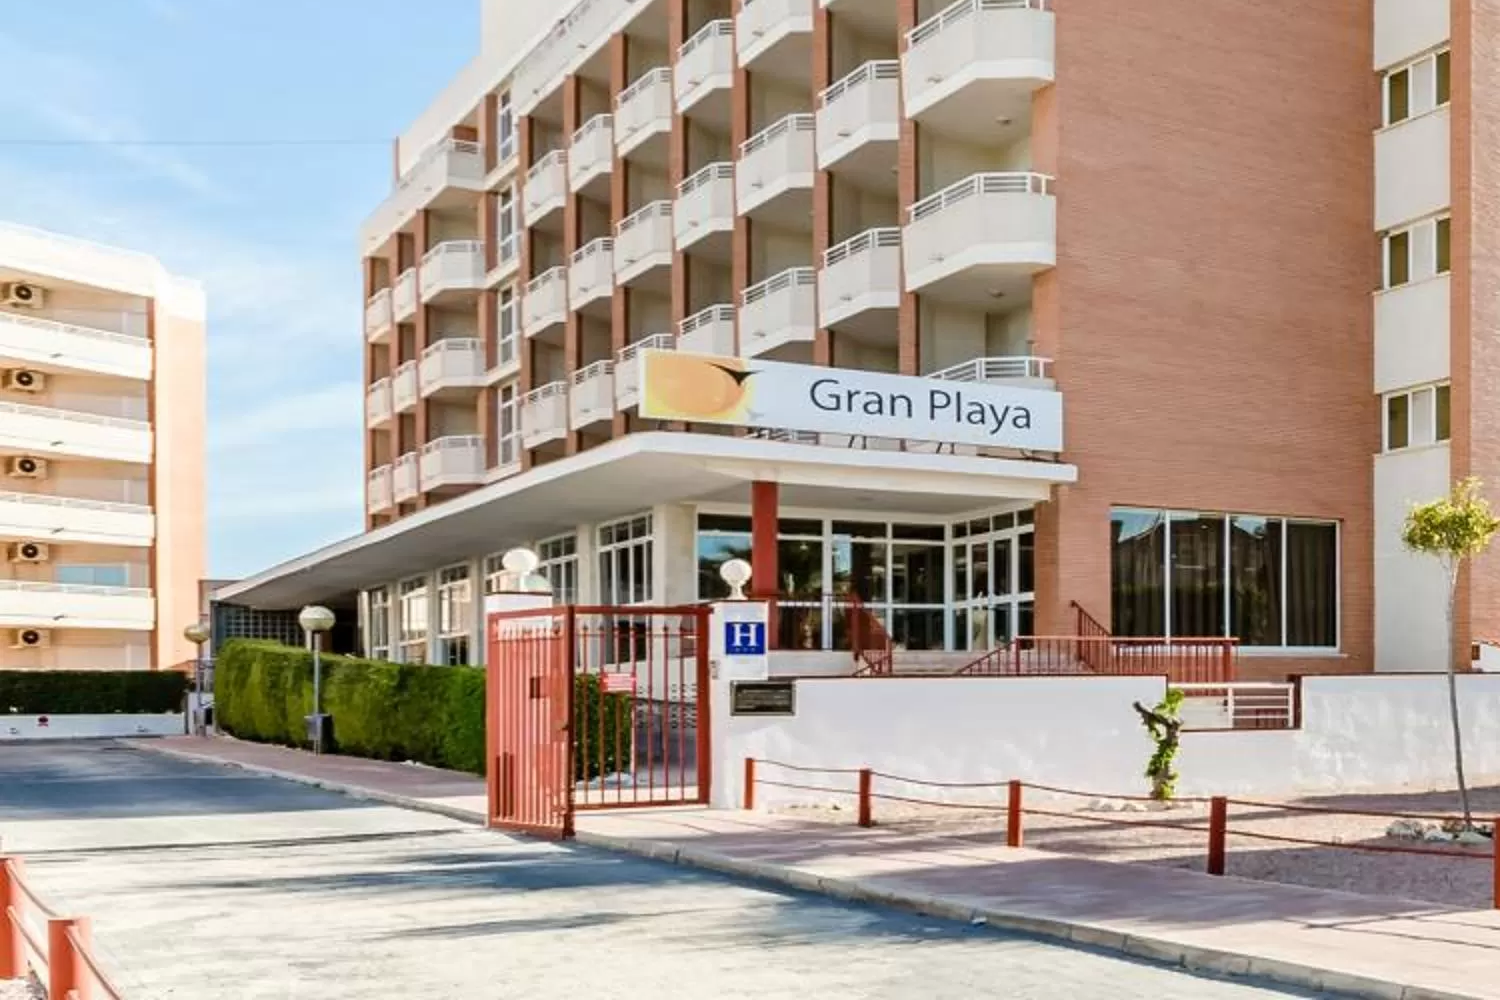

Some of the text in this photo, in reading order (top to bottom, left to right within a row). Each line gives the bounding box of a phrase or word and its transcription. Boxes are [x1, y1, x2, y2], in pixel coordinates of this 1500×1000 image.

[809, 378, 1032, 435] Gran Playa
[731, 623, 759, 647] H
